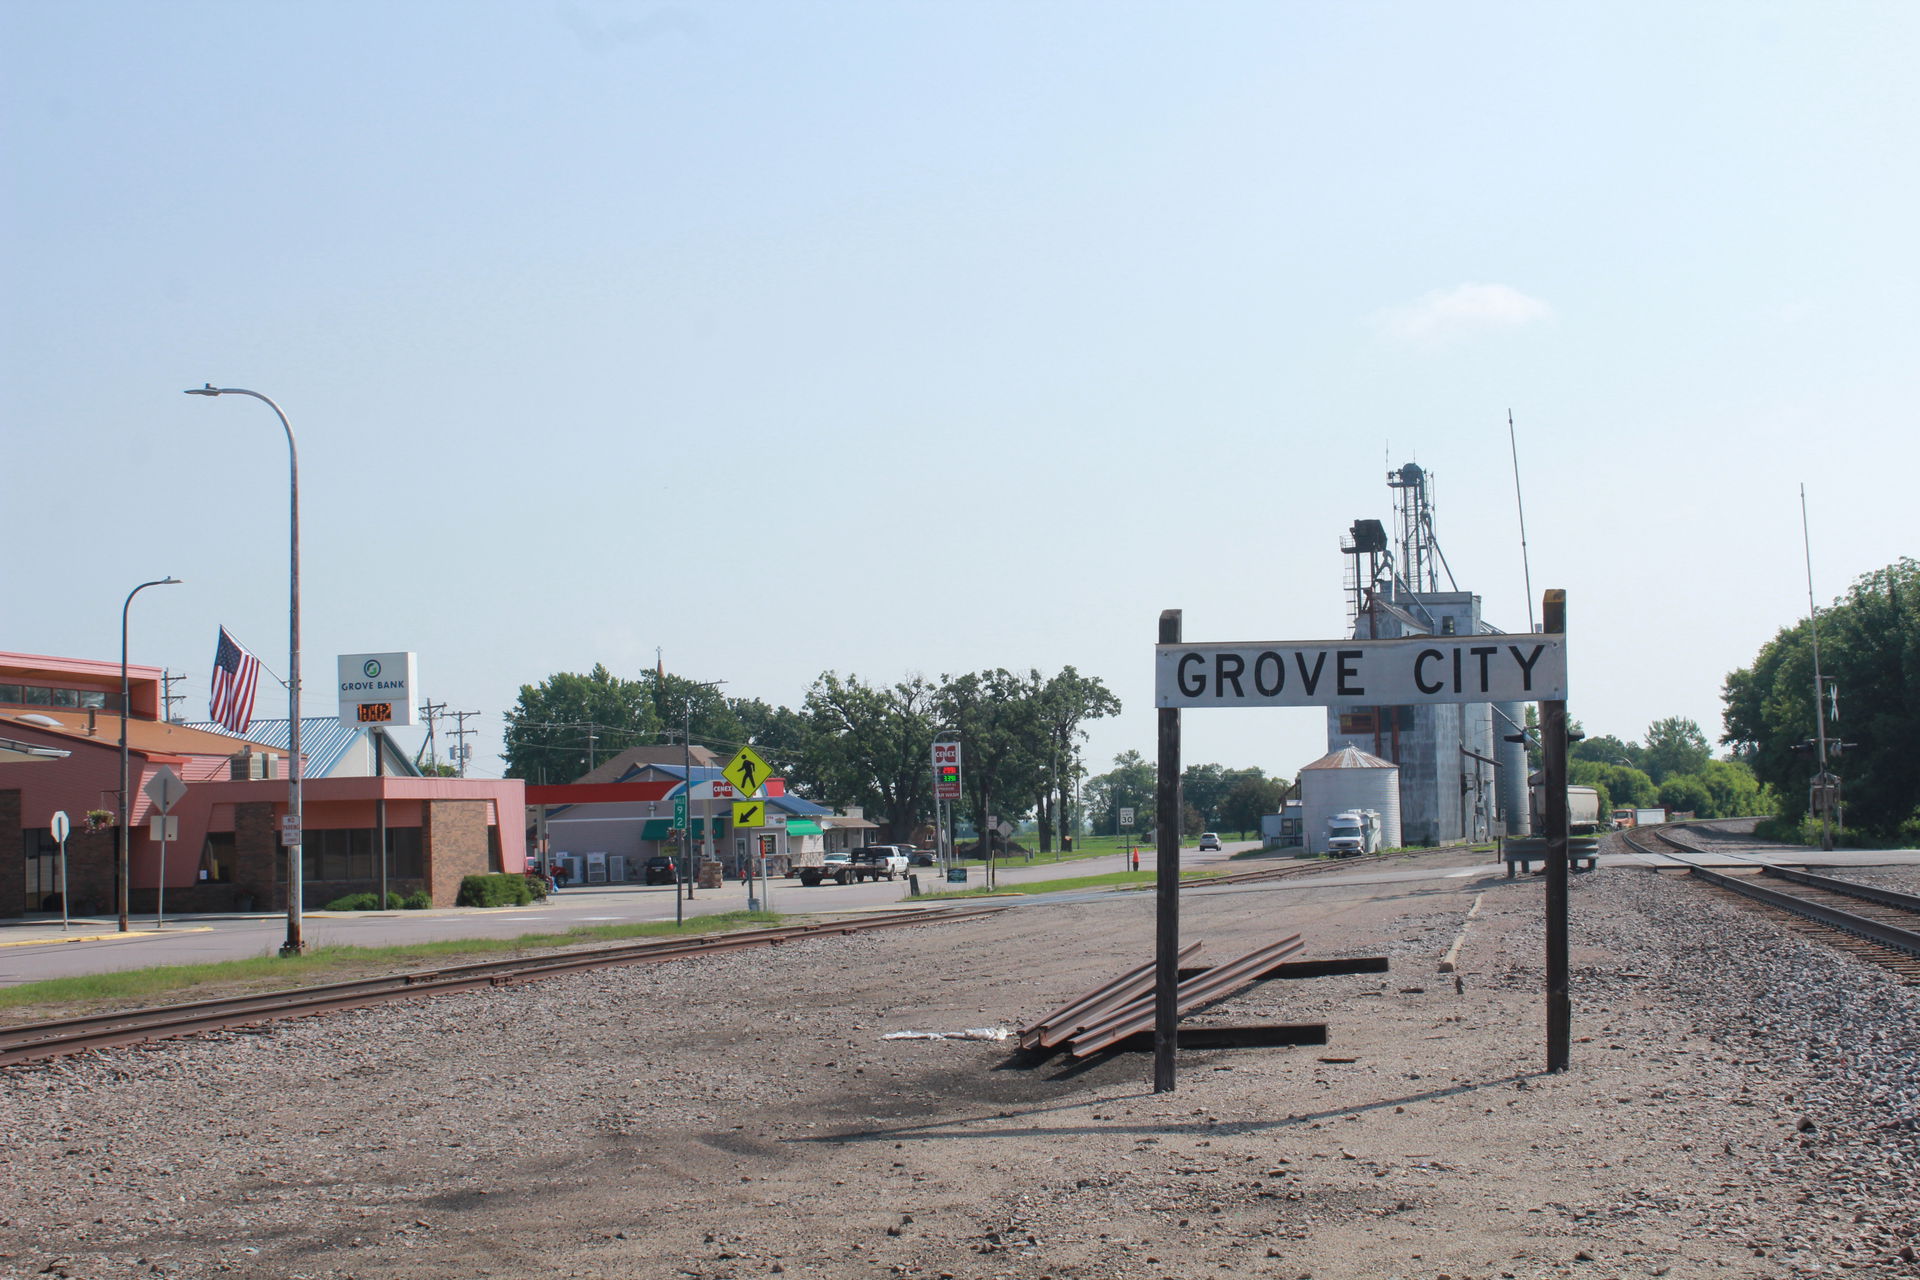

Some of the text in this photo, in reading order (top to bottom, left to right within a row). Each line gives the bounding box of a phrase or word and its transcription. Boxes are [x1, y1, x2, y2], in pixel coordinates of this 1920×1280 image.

[341, 680, 405, 691] GROVE BANK
[1177, 645, 1545, 698] GROVE CITY
